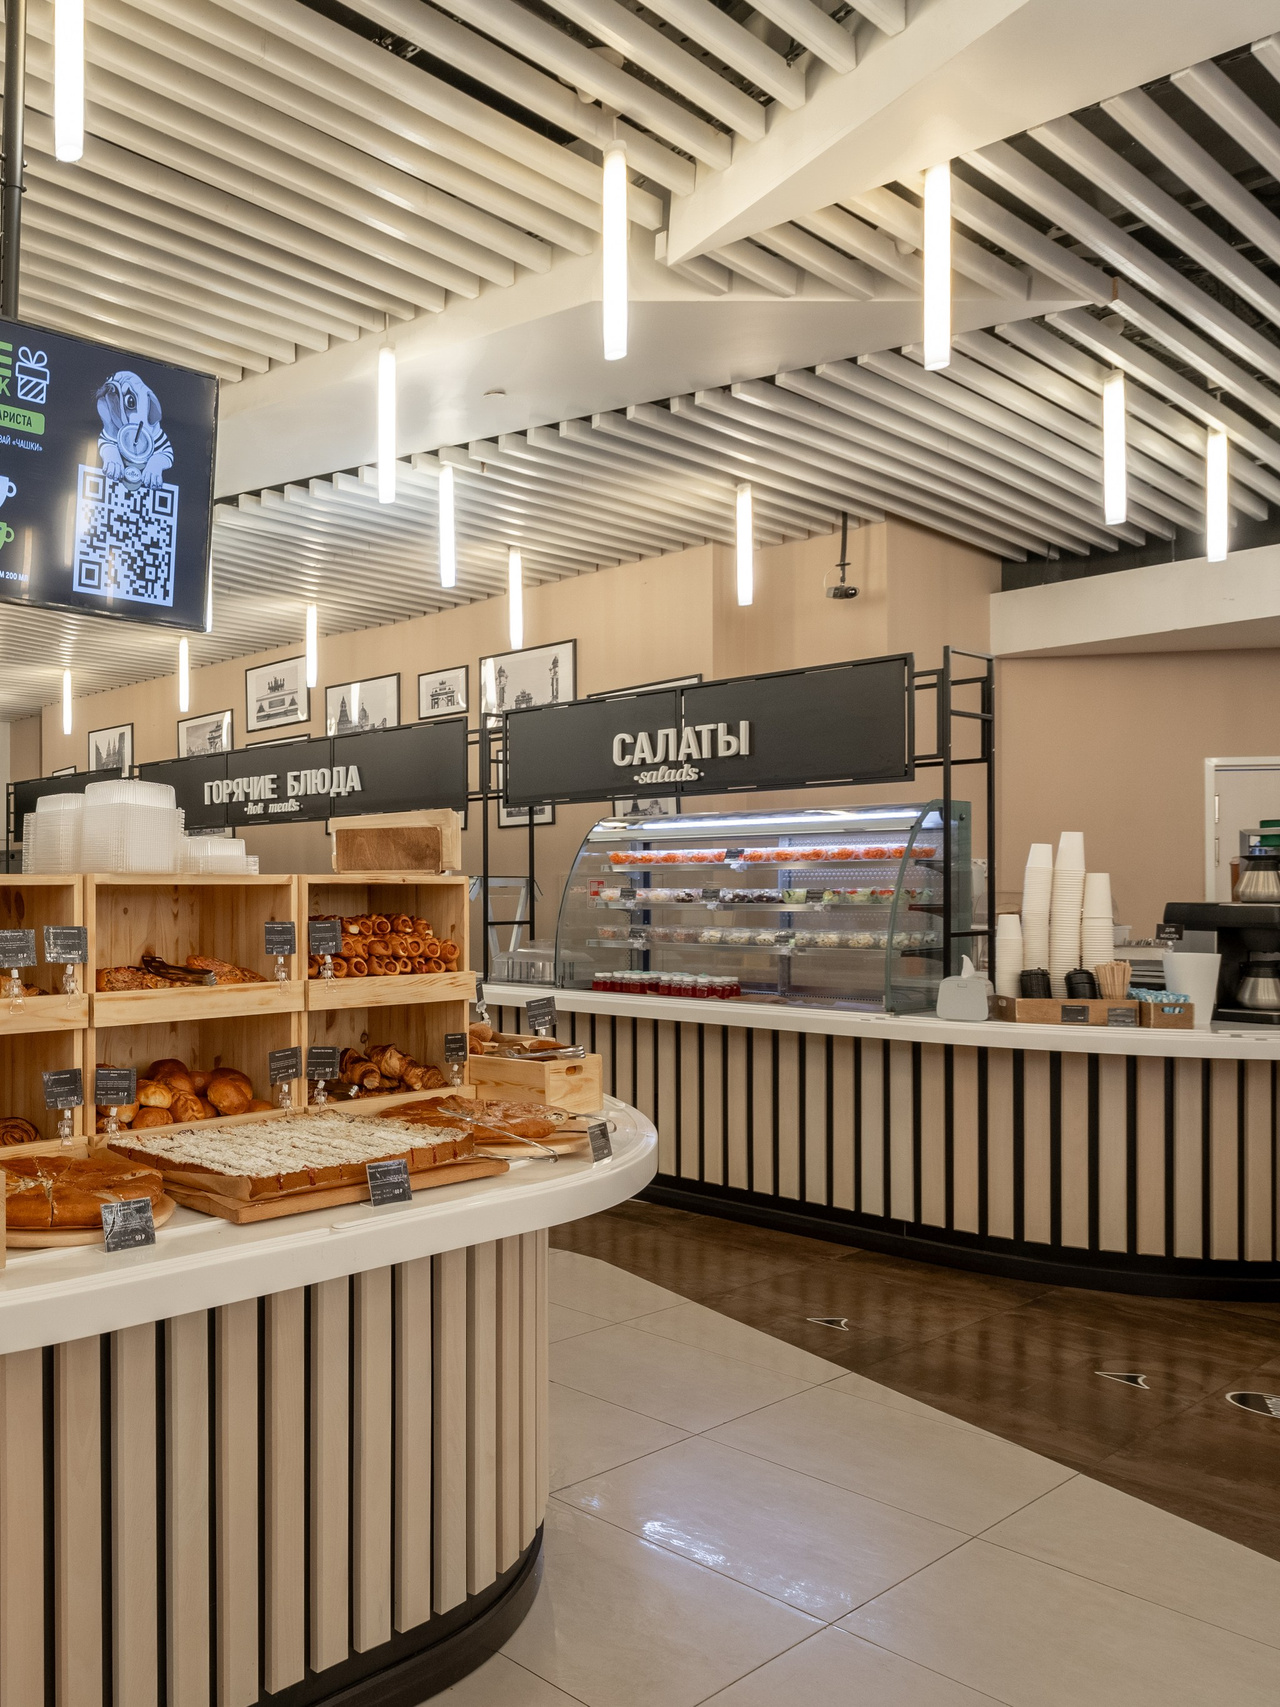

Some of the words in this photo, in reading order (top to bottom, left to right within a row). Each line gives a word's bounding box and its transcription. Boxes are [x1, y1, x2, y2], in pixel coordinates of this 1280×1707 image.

[12, 438, 43, 452] «ЧАШКИ»
[6, 571, 18, 580] 200
[18, 573, 29, 582] МЛ
[612, 720, 751, 767] САЛАТЫ
[638, 764, 699, 784] salads
[204, 774, 278, 805] ГОРЯЧИЕ
[287, 765, 362, 797] БЛЮДА
[247, 802, 264, 815] hot
[268, 798, 300, 814] meals
